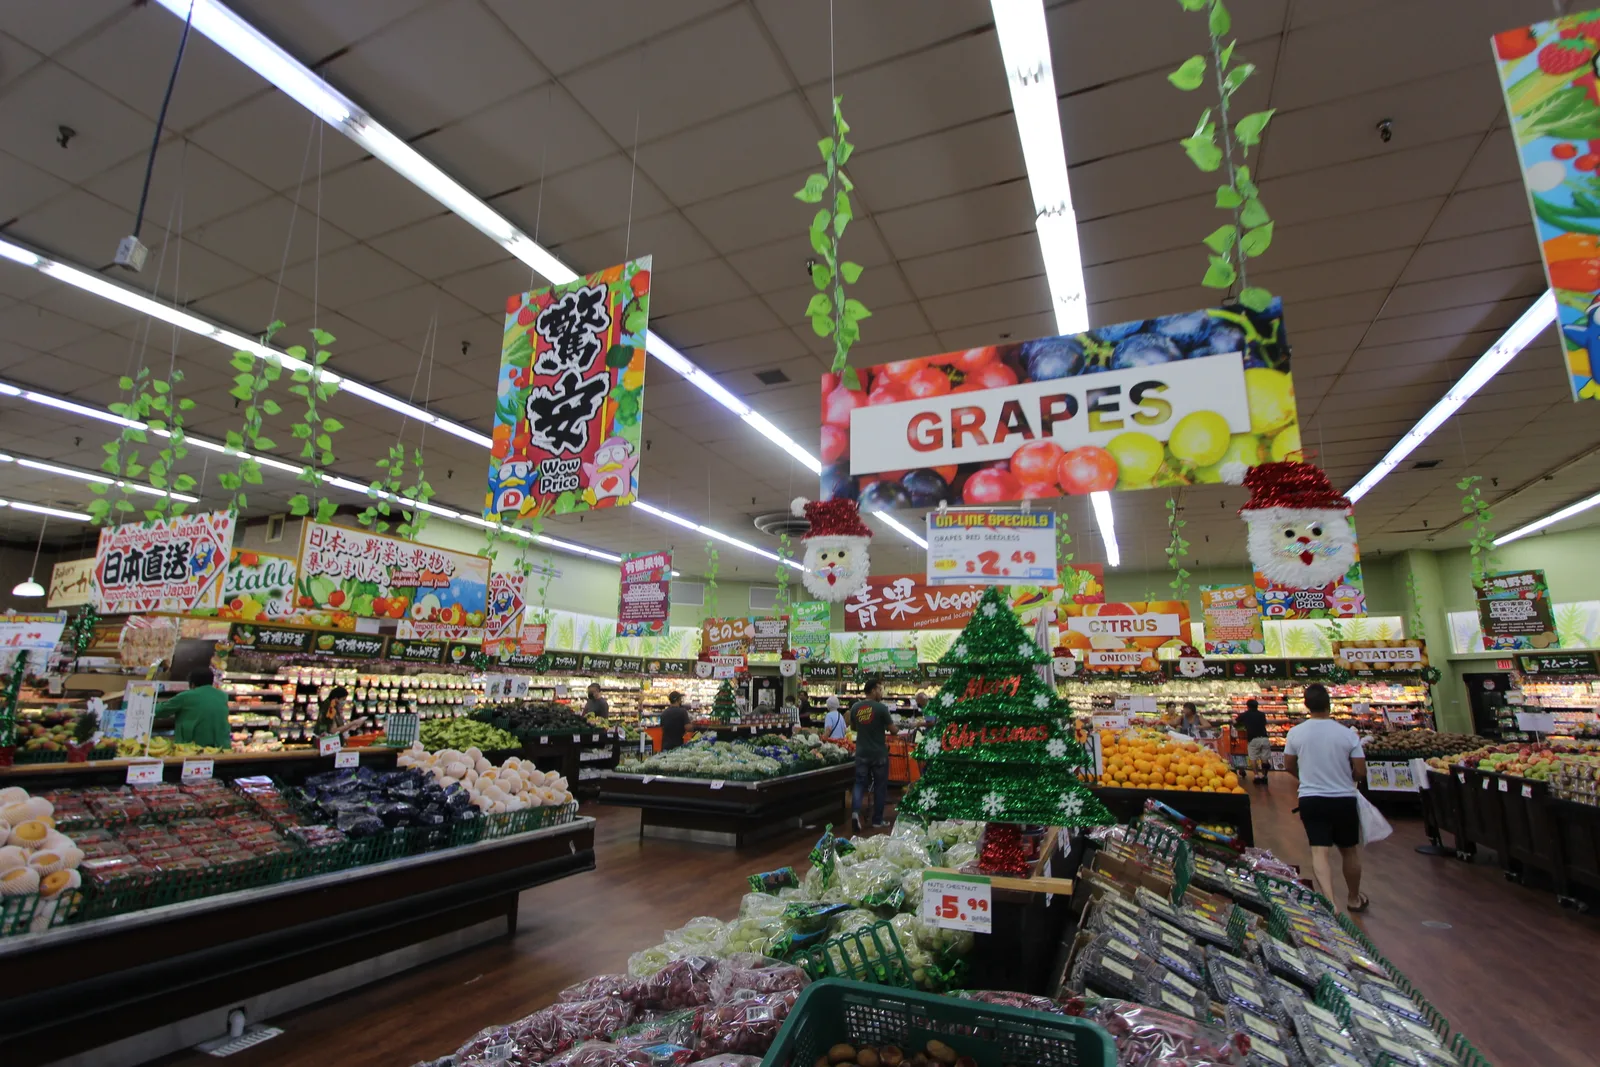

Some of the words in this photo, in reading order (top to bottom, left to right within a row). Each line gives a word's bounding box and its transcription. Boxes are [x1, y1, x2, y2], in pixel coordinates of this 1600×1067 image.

[905, 380, 1173, 454] GRAPES
[542, 459, 580, 476] Wow
[541, 475, 579, 492] Price
[935, 514, 986, 528] ON-LINE
[987, 514, 1048, 527] SPECIALS
[113, 531, 150, 548] Imported
[150, 529, 171, 542] from
[171, 523, 208, 539] Japan
[934, 535, 963, 543] GRAPES
[984, 534, 1020, 542] SEEDLESS
[308, 526, 456, 576] 日本の野菜と果物を
[103, 541, 190, 584] 日本直送
[306, 551, 391, 586] 集めました。
[54, 566, 76, 580] Bakery
[390, 569, 421, 580] Japanese
[390, 578, 421, 588] vegetables
[421, 579, 434, 587] and
[434, 579, 450, 588] fruits
[104, 588, 140, 602] Imported
[141, 587, 162, 599] from
[163, 583, 198, 597] Japan
[1294, 591, 1324, 600] Wow
[845, 577, 923, 629] 青果
[1296, 600, 1325, 609] Price
[913, 617, 940, 628] Imported
[940, 613, 952, 622] and
[953, 610, 972, 620] locally
[1088, 618, 1158, 633] CITRUS
[709, 621, 744, 642] きのこ
[1099, 654, 1142, 663] ONIONS
[1346, 649, 1415, 661] POTATOES
[1541, 658, 1589, 669] スムージー
[955, 674, 1022, 703] Merry
[927, 881, 945, 889] NUTS
[946, 883, 978, 892] CHESTNUT
[935, 894, 989, 921] $5.99
